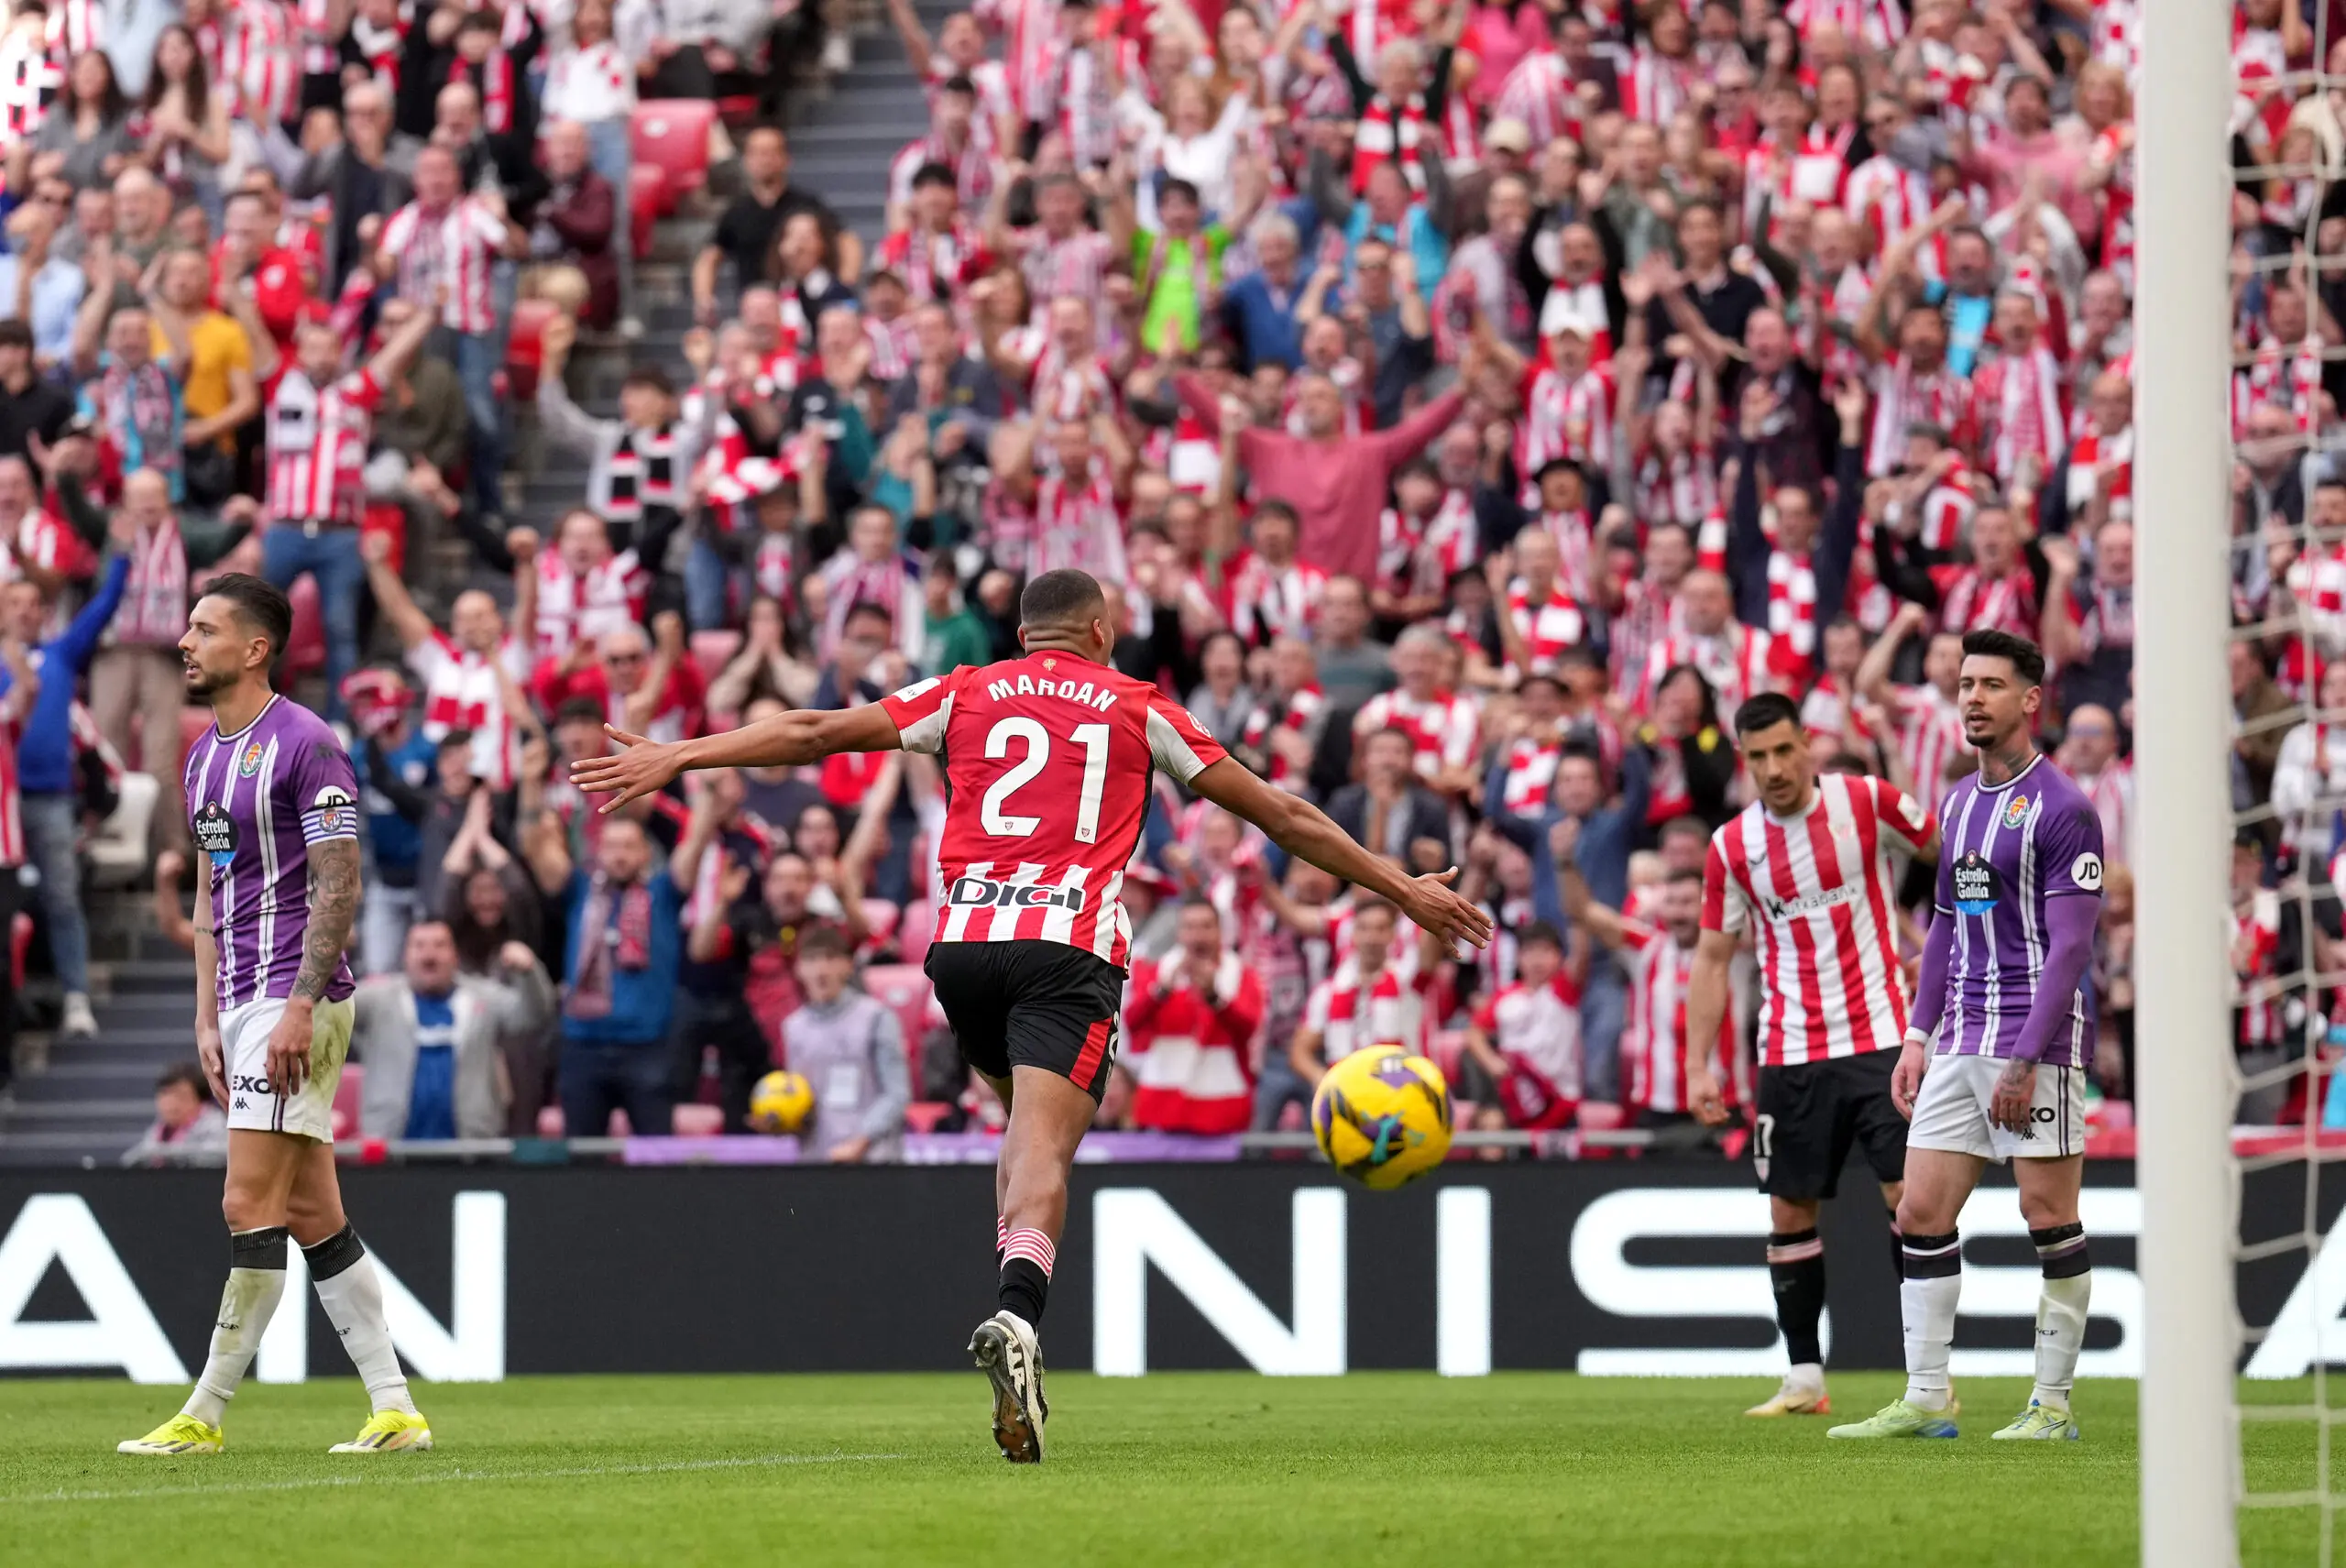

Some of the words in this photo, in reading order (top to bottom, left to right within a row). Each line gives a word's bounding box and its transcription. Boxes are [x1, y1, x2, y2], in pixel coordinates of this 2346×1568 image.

[987, 674, 1118, 713] MAROAN
[980, 716, 1111, 845] 21
[195, 817, 230, 833] Estrella
[201, 834, 231, 850] Galicia
[1955, 868, 1990, 883] Estrella
[2077, 861, 2099, 882] JD
[1957, 883, 1990, 899] Galicia
